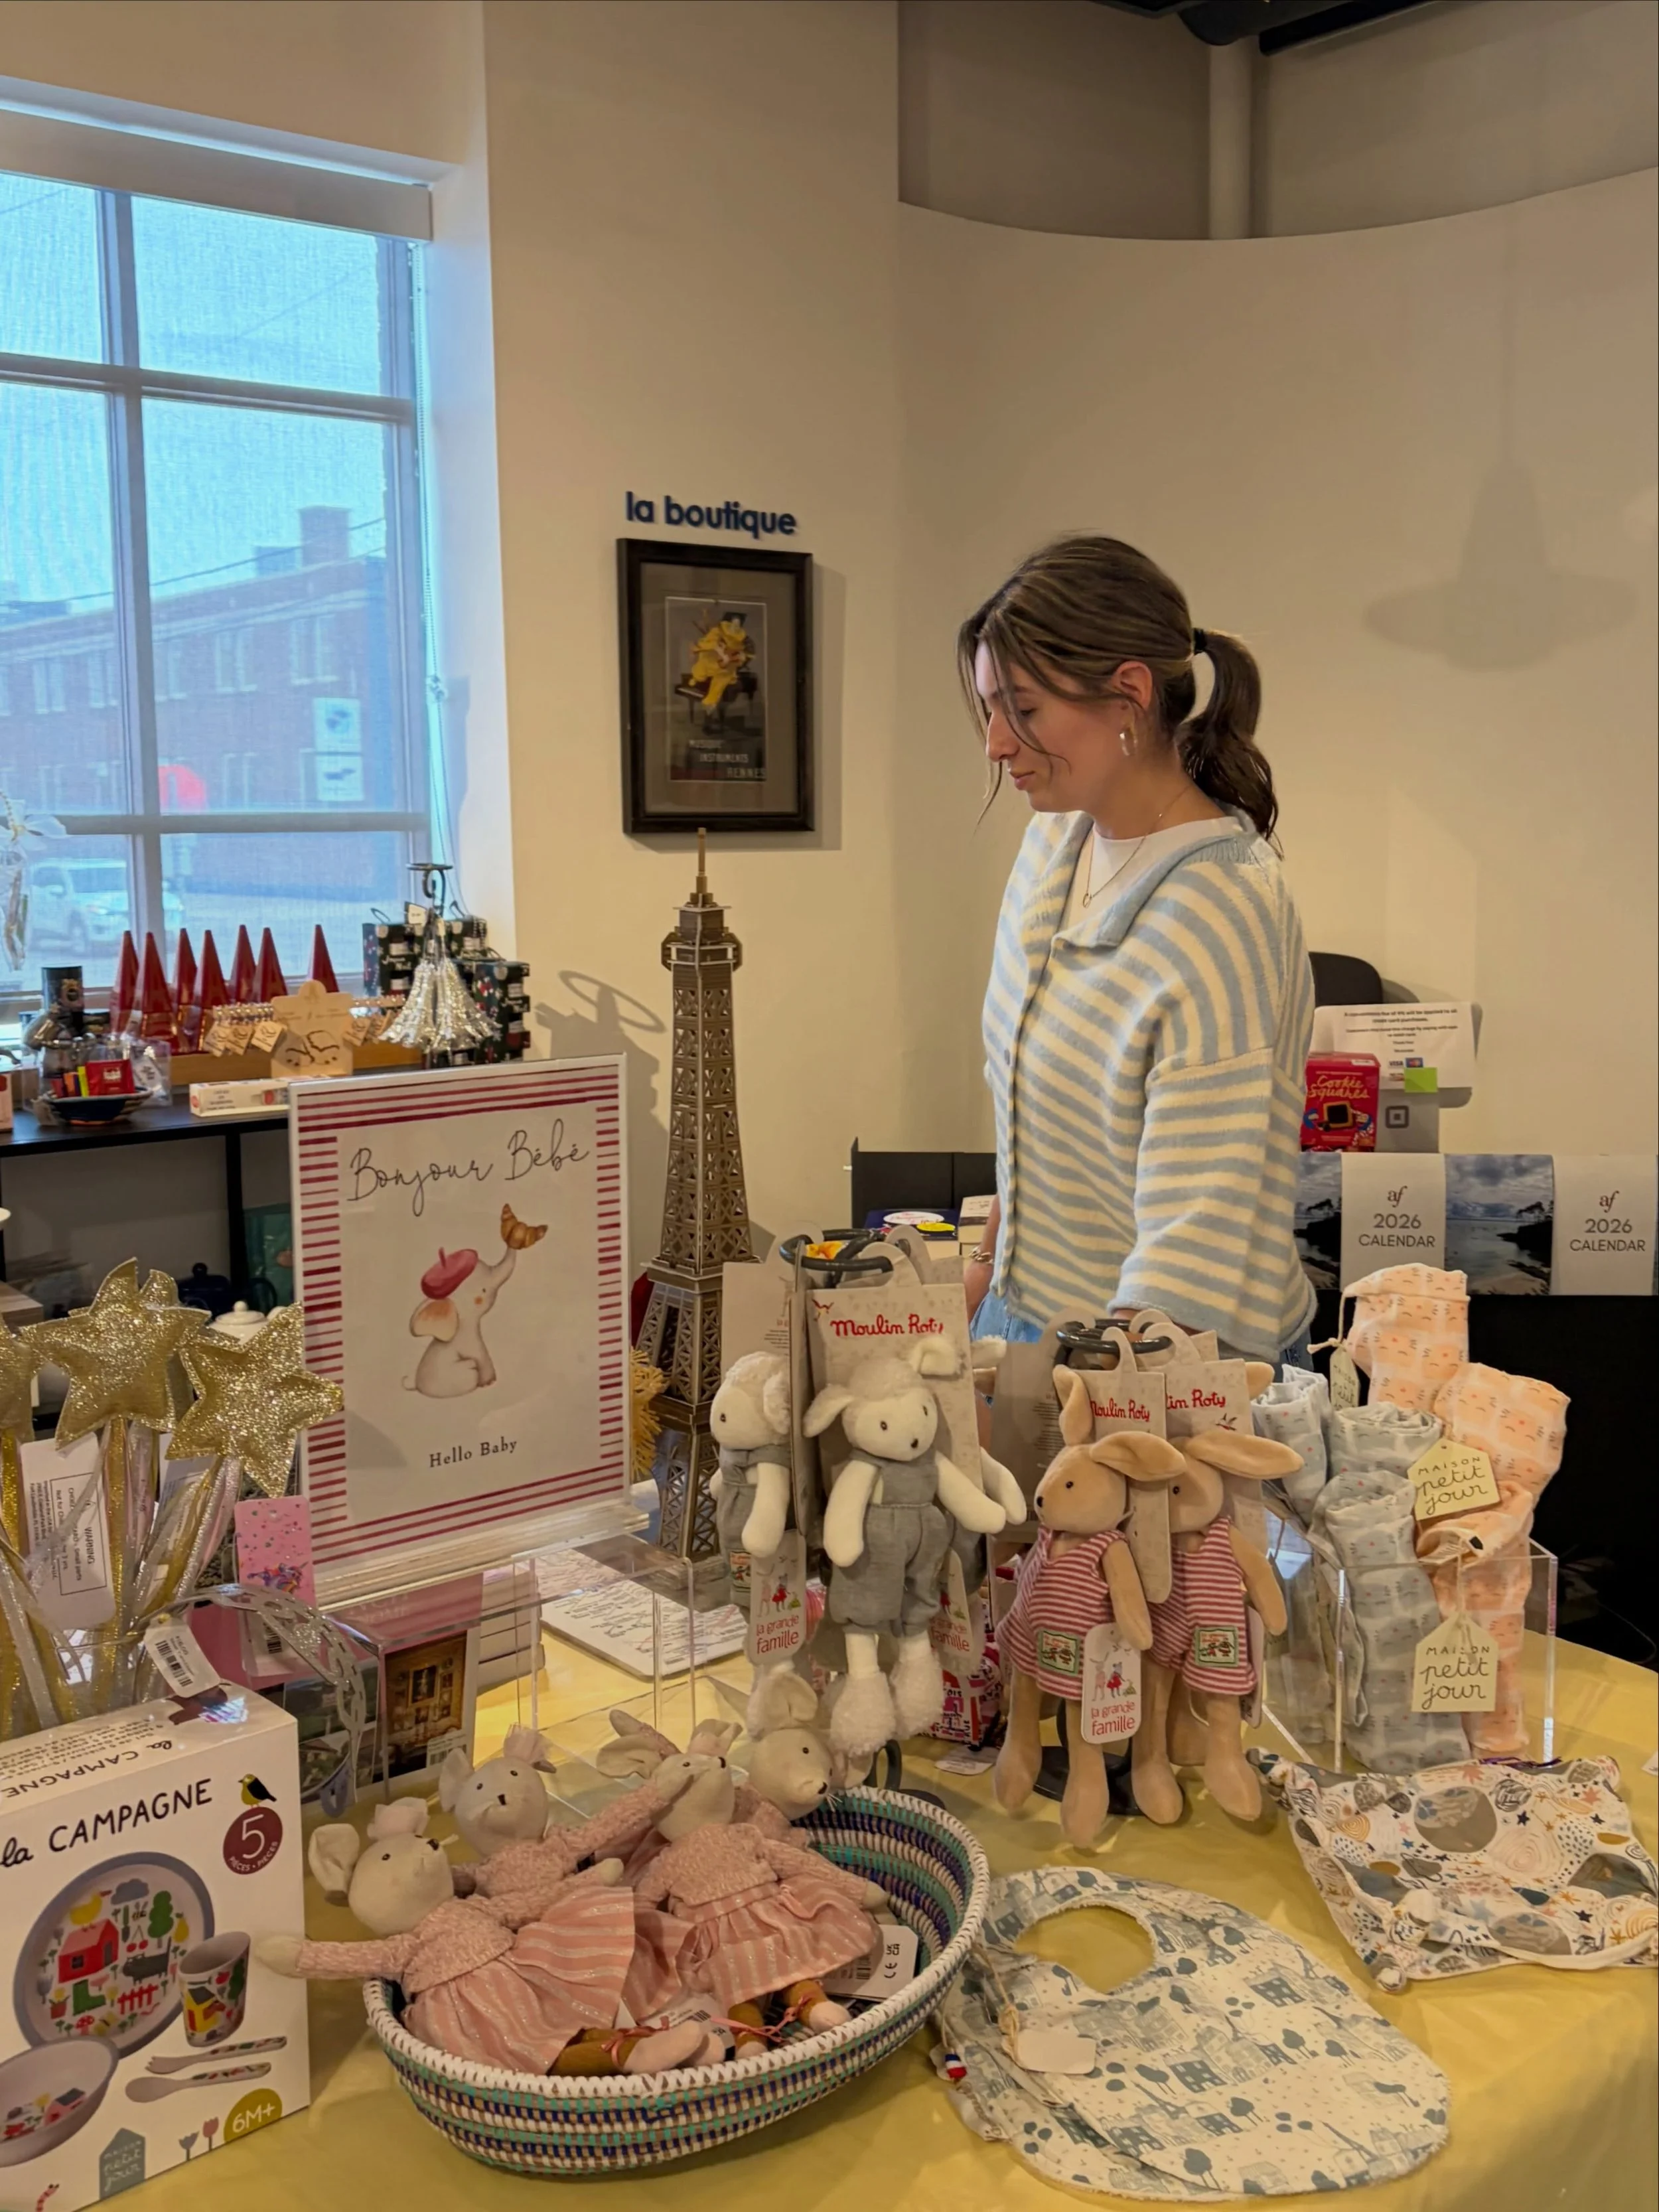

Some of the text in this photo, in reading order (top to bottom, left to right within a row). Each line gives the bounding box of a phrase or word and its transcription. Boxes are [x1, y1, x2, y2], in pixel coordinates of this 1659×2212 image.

[626, 491, 796, 540] la boutique
[1317, 1075, 1364, 1088] Cookie
[347, 1118, 589, 1217] Bonjour Bébé
[1388, 1185, 1407, 1208] af
[1599, 1191, 1619, 1213] af
[1373, 1213, 1421, 1229] 2026
[1585, 1218, 1632, 1234] 2026
[1358, 1234, 1435, 1248] CALENDAR
[1569, 1239, 1646, 1252] CALENDAR
[830, 1314, 904, 1337] Moulin
[1192, 1389, 1226, 1408] Roty
[1128, 1399, 1150, 1422] Roty
[429, 1436, 517, 1467] Hello Baby
[1418, 1457, 1480, 1475] MAISON
[1416, 1465, 1486, 1497] petit
[1425, 1485, 1489, 1515] jour
[84, 1526, 96, 1564] WARNING
[767, 1615, 800, 1634] grande
[757, 1629, 799, 1654] famille
[1419, 1657, 1488, 1684] petit
[1421, 1683, 1486, 1710] jour
[1102, 1700, 1135, 1718] grande
[1092, 1715, 1135, 1735] famille
[147, 1739, 173, 1750] la
[1, 1750, 139, 1798] CAMPAGNE
[0, 1778, 212, 1868] la CAMPAGNE
[242, 1814, 265, 1859] 5
[233, 2102, 275, 2132] 6M+
